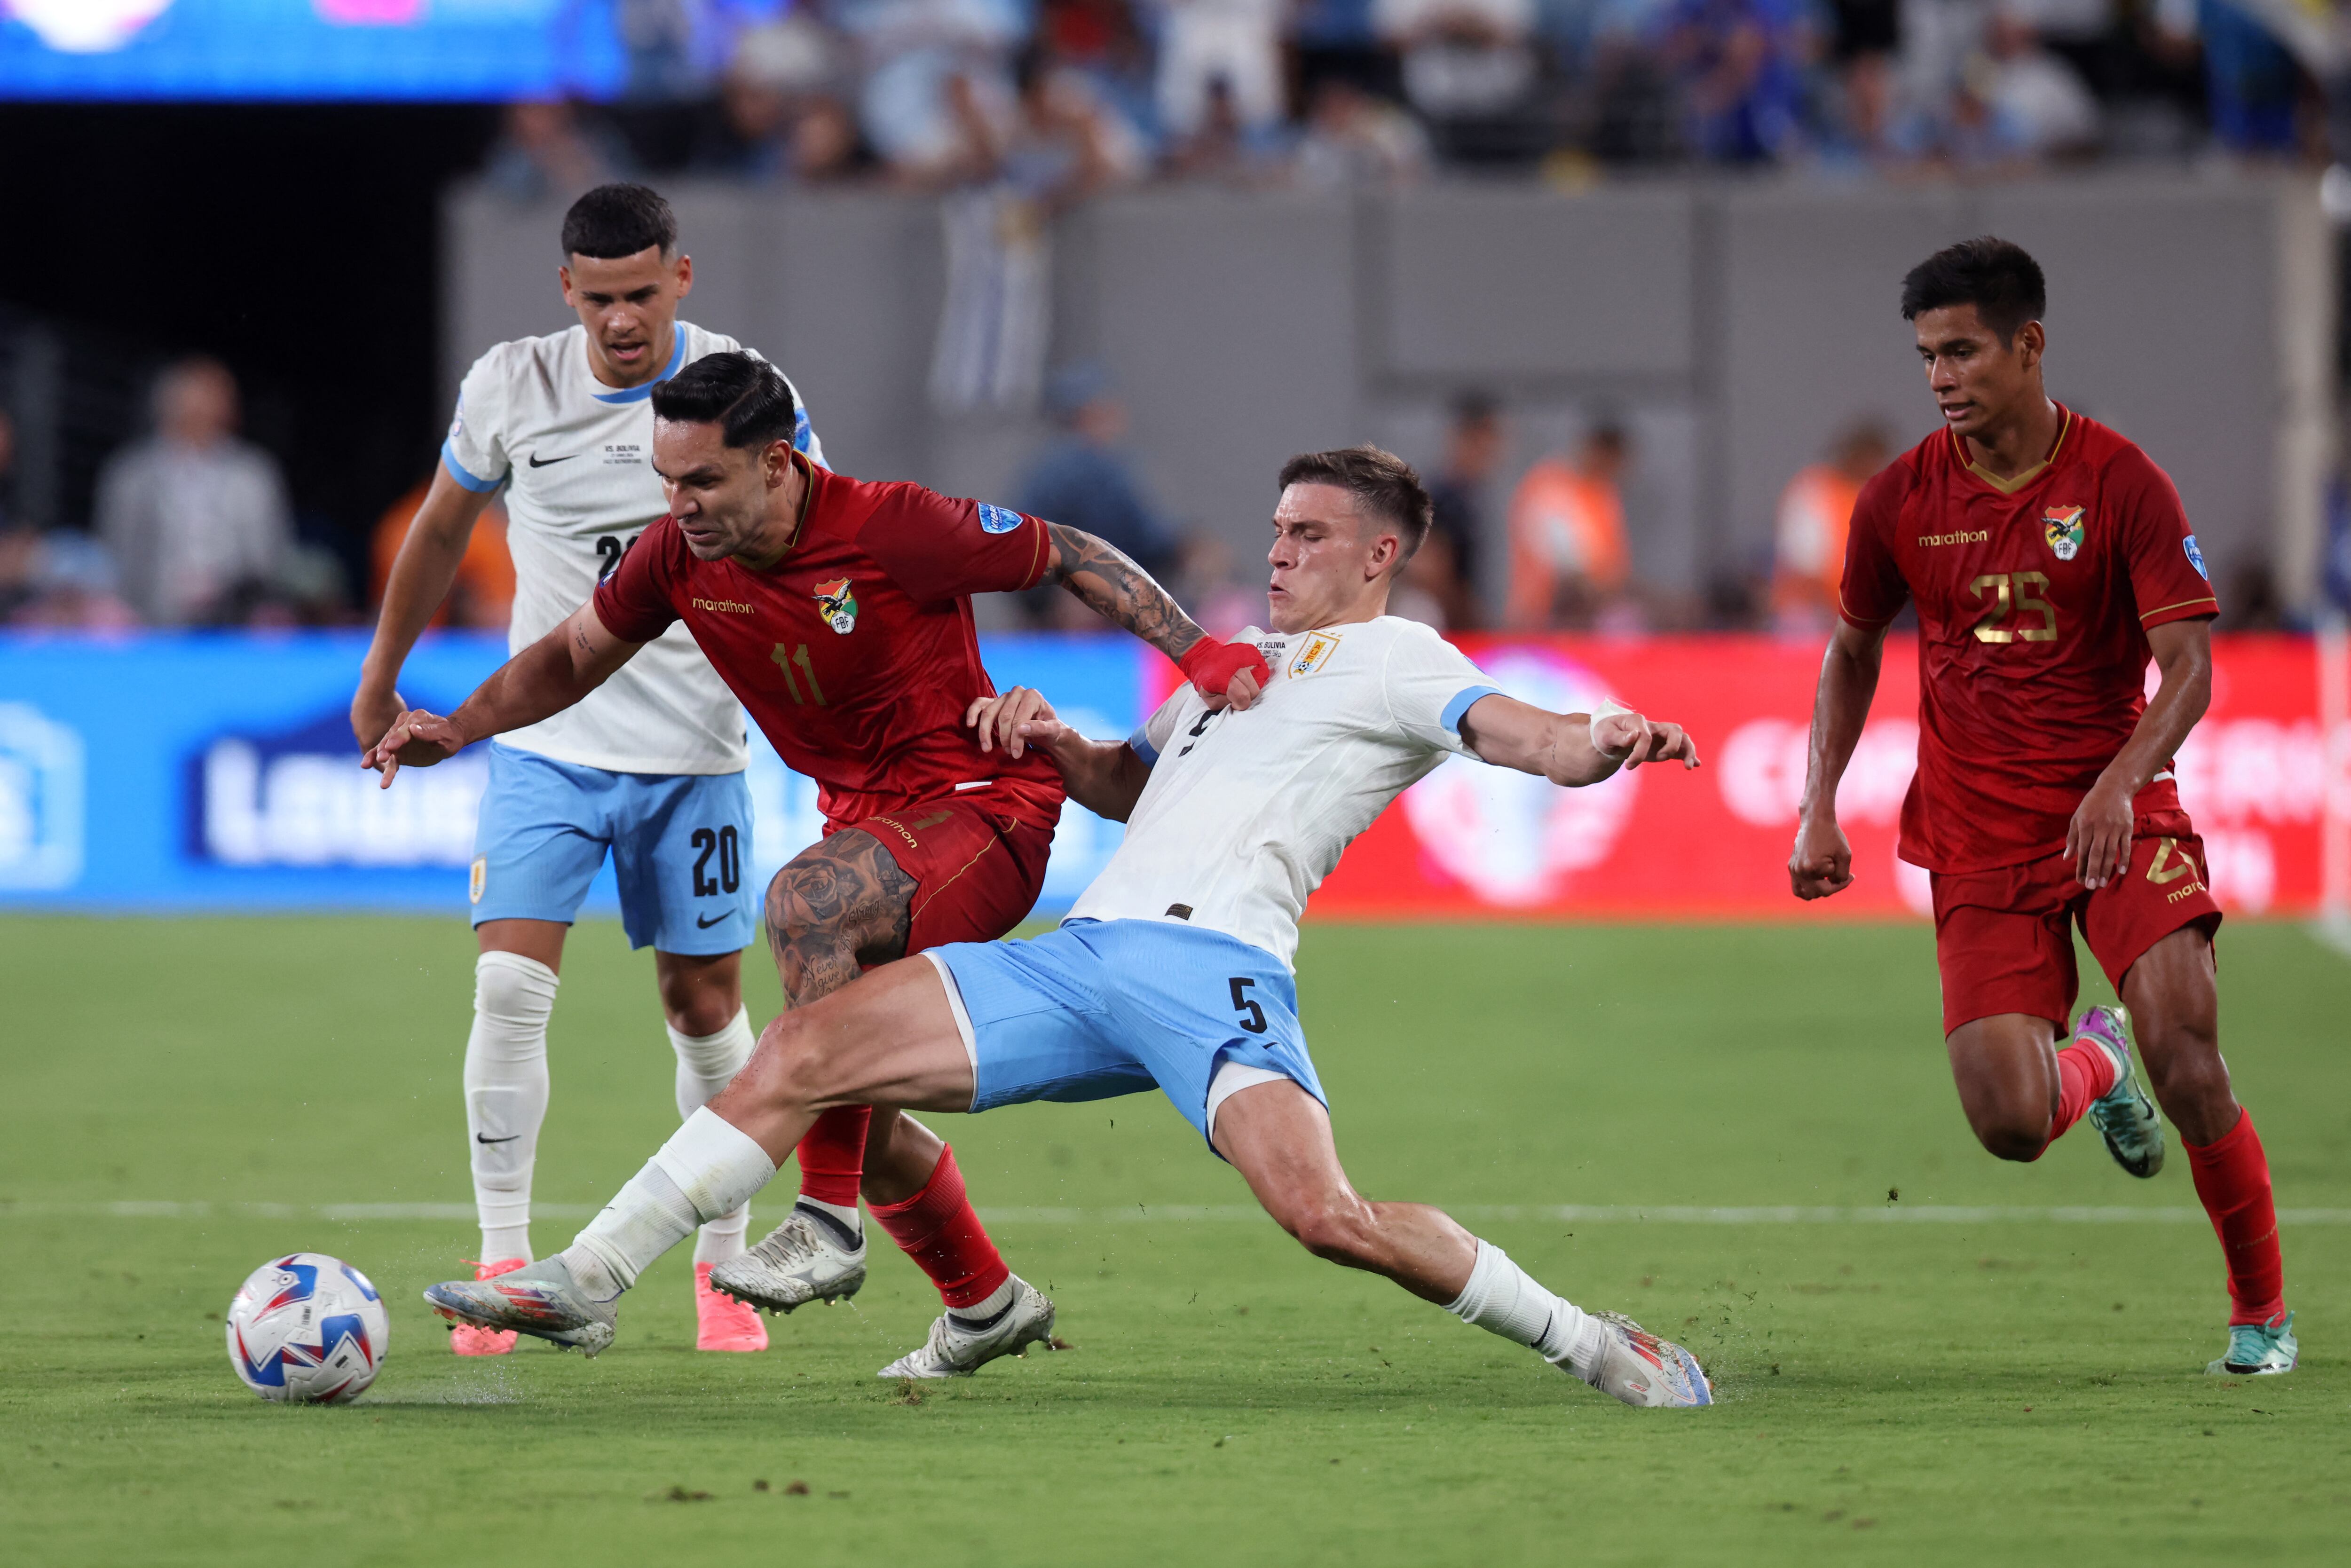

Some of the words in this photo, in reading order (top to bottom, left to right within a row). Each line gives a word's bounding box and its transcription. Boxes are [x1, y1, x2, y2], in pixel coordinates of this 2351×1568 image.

[1918, 530, 1987, 547] marathon
[2059, 543, 2072, 555] FBF
[597, 536, 639, 580] 2
[693, 598, 754, 614] marathon
[1970, 571, 2057, 643] 25
[835, 616, 849, 629] FBF
[1306, 644, 1321, 660] AUF
[770, 643, 828, 706] 11
[691, 824, 739, 897] 20
[849, 899, 880, 930] Strong
[802, 956, 838, 988] Never
[1228, 977, 1268, 1034] 5
